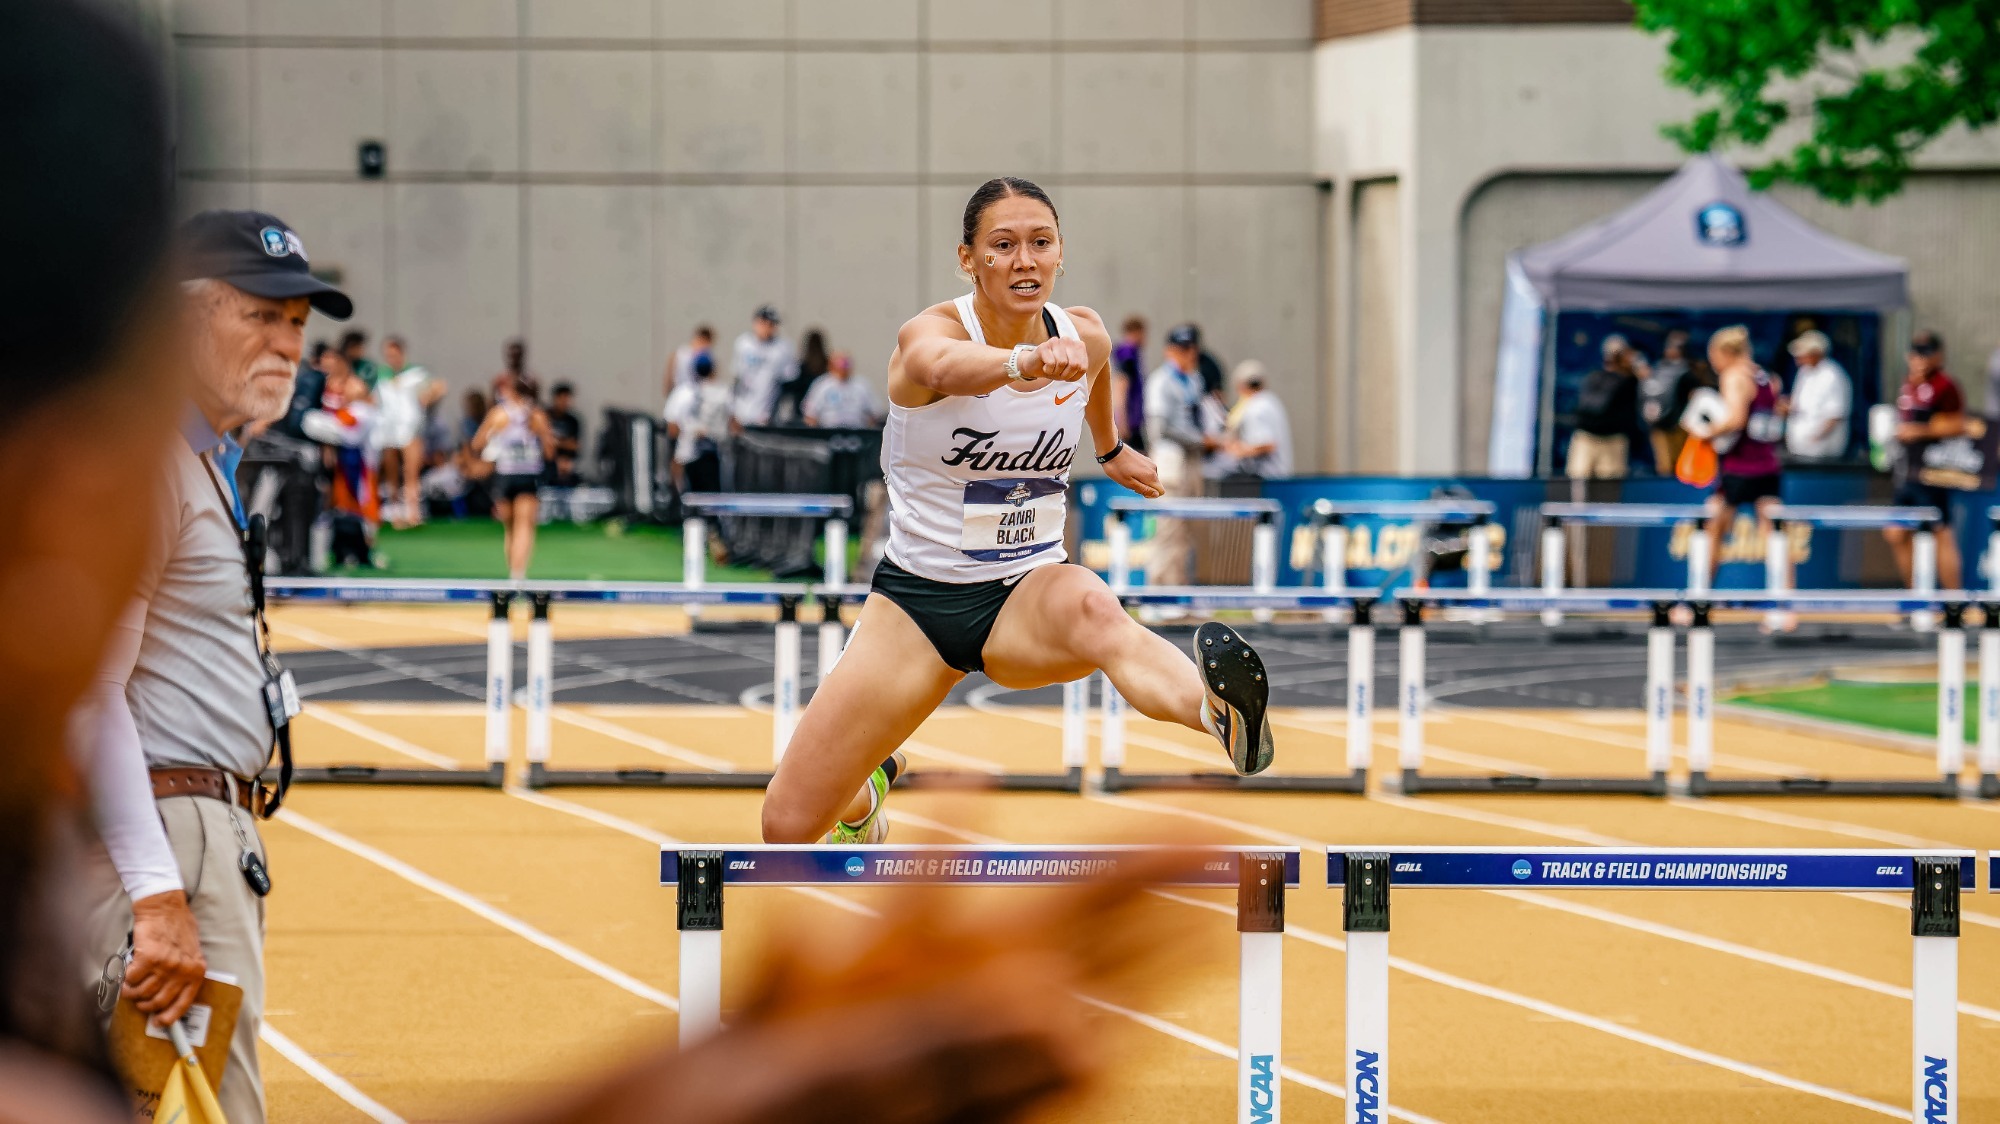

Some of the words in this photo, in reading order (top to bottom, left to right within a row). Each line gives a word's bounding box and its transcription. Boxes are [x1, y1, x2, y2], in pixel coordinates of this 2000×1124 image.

[941, 427, 1077, 480] Findla
[999, 508, 1036, 527] ZANRI
[996, 526, 1035, 545] BLACK
[729, 861, 756, 870] GILL
[875, 859, 925, 876] TRACK
[927, 859, 940, 876] &
[940, 859, 983, 876] FIELD
[986, 859, 1118, 877] CHAMPIONSHIPS
[1203, 861, 1231, 871] GILL
[1395, 862, 1422, 872] GILL
[1513, 867, 1532, 875] NCAA
[1541, 861, 1592, 879] TRACK
[1593, 861, 1607, 879] &
[1608, 862, 1651, 880] FIELD
[1654, 862, 1788, 881] CHAMPIONSHIPS
[1876, 866, 1903, 875] GILL
[1924, 1055, 1948, 1124] NCA
